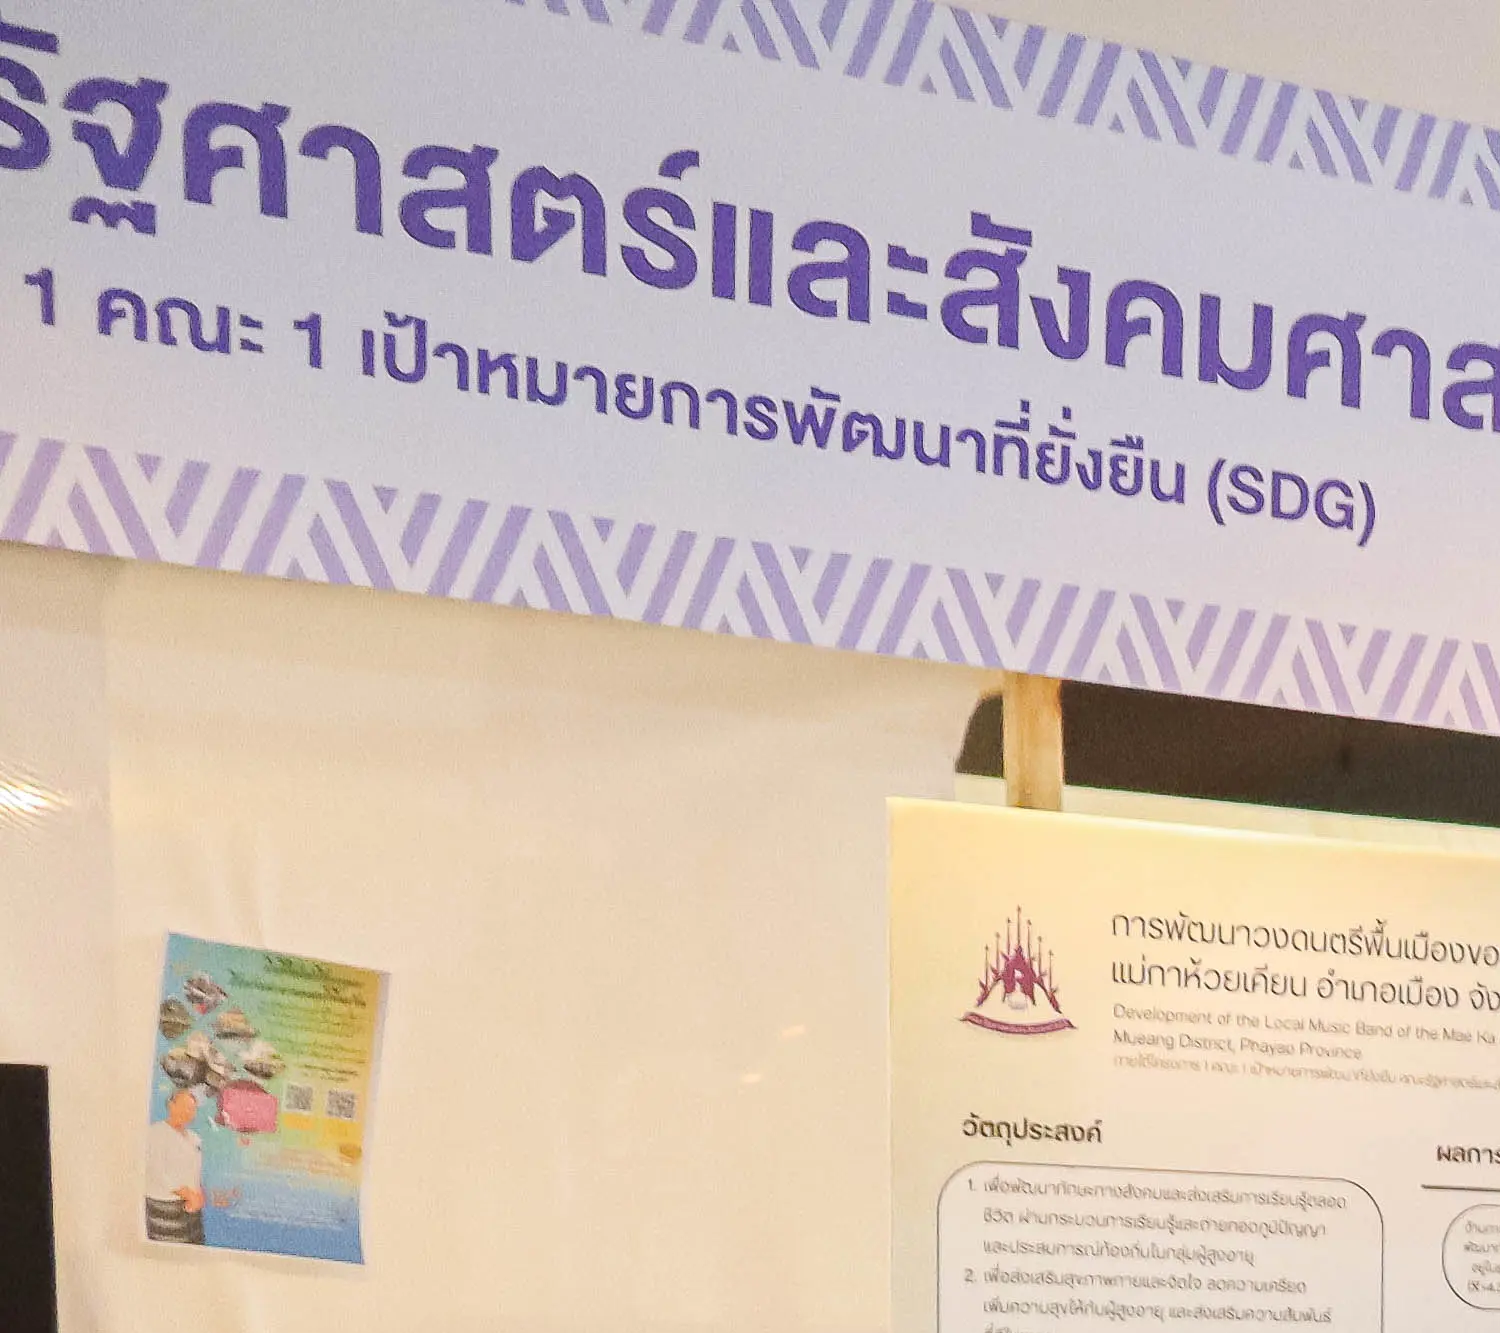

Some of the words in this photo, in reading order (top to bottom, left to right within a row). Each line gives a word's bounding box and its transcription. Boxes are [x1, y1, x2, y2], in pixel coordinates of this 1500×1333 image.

[25, 269, 57, 326] 1
[97, 284, 264, 356] คณะ
[294, 315, 324, 369] 1
[362, 315, 1186, 505] เป้าหมายการพัฒนาที่ยั่งยืน
[1208, 458, 1377, 548] (SDG)
[1111, 953, 1307, 997] แม่กาห้วยเคียน
[1316, 969, 1459, 1009] อำเภอเมือง
[1113, 1004, 1212, 1026] Development
[1217, 1013, 1232, 1026] of
[1236, 1014, 1260, 1028] the
[1264, 1015, 1304, 1031] Local
[1308, 1018, 1350, 1035] Music
[1355, 1021, 1393, 1039] Band
[1397, 1024, 1412, 1038] of
[1415, 1026, 1438, 1041] the
[1112, 1030, 1175, 1051] Mueang
[1239, 1036, 1296, 1059] Phayao
[1299, 1041, 1363, 1061] Province
[962, 1111, 1104, 1147] วัตถุประสงค์
